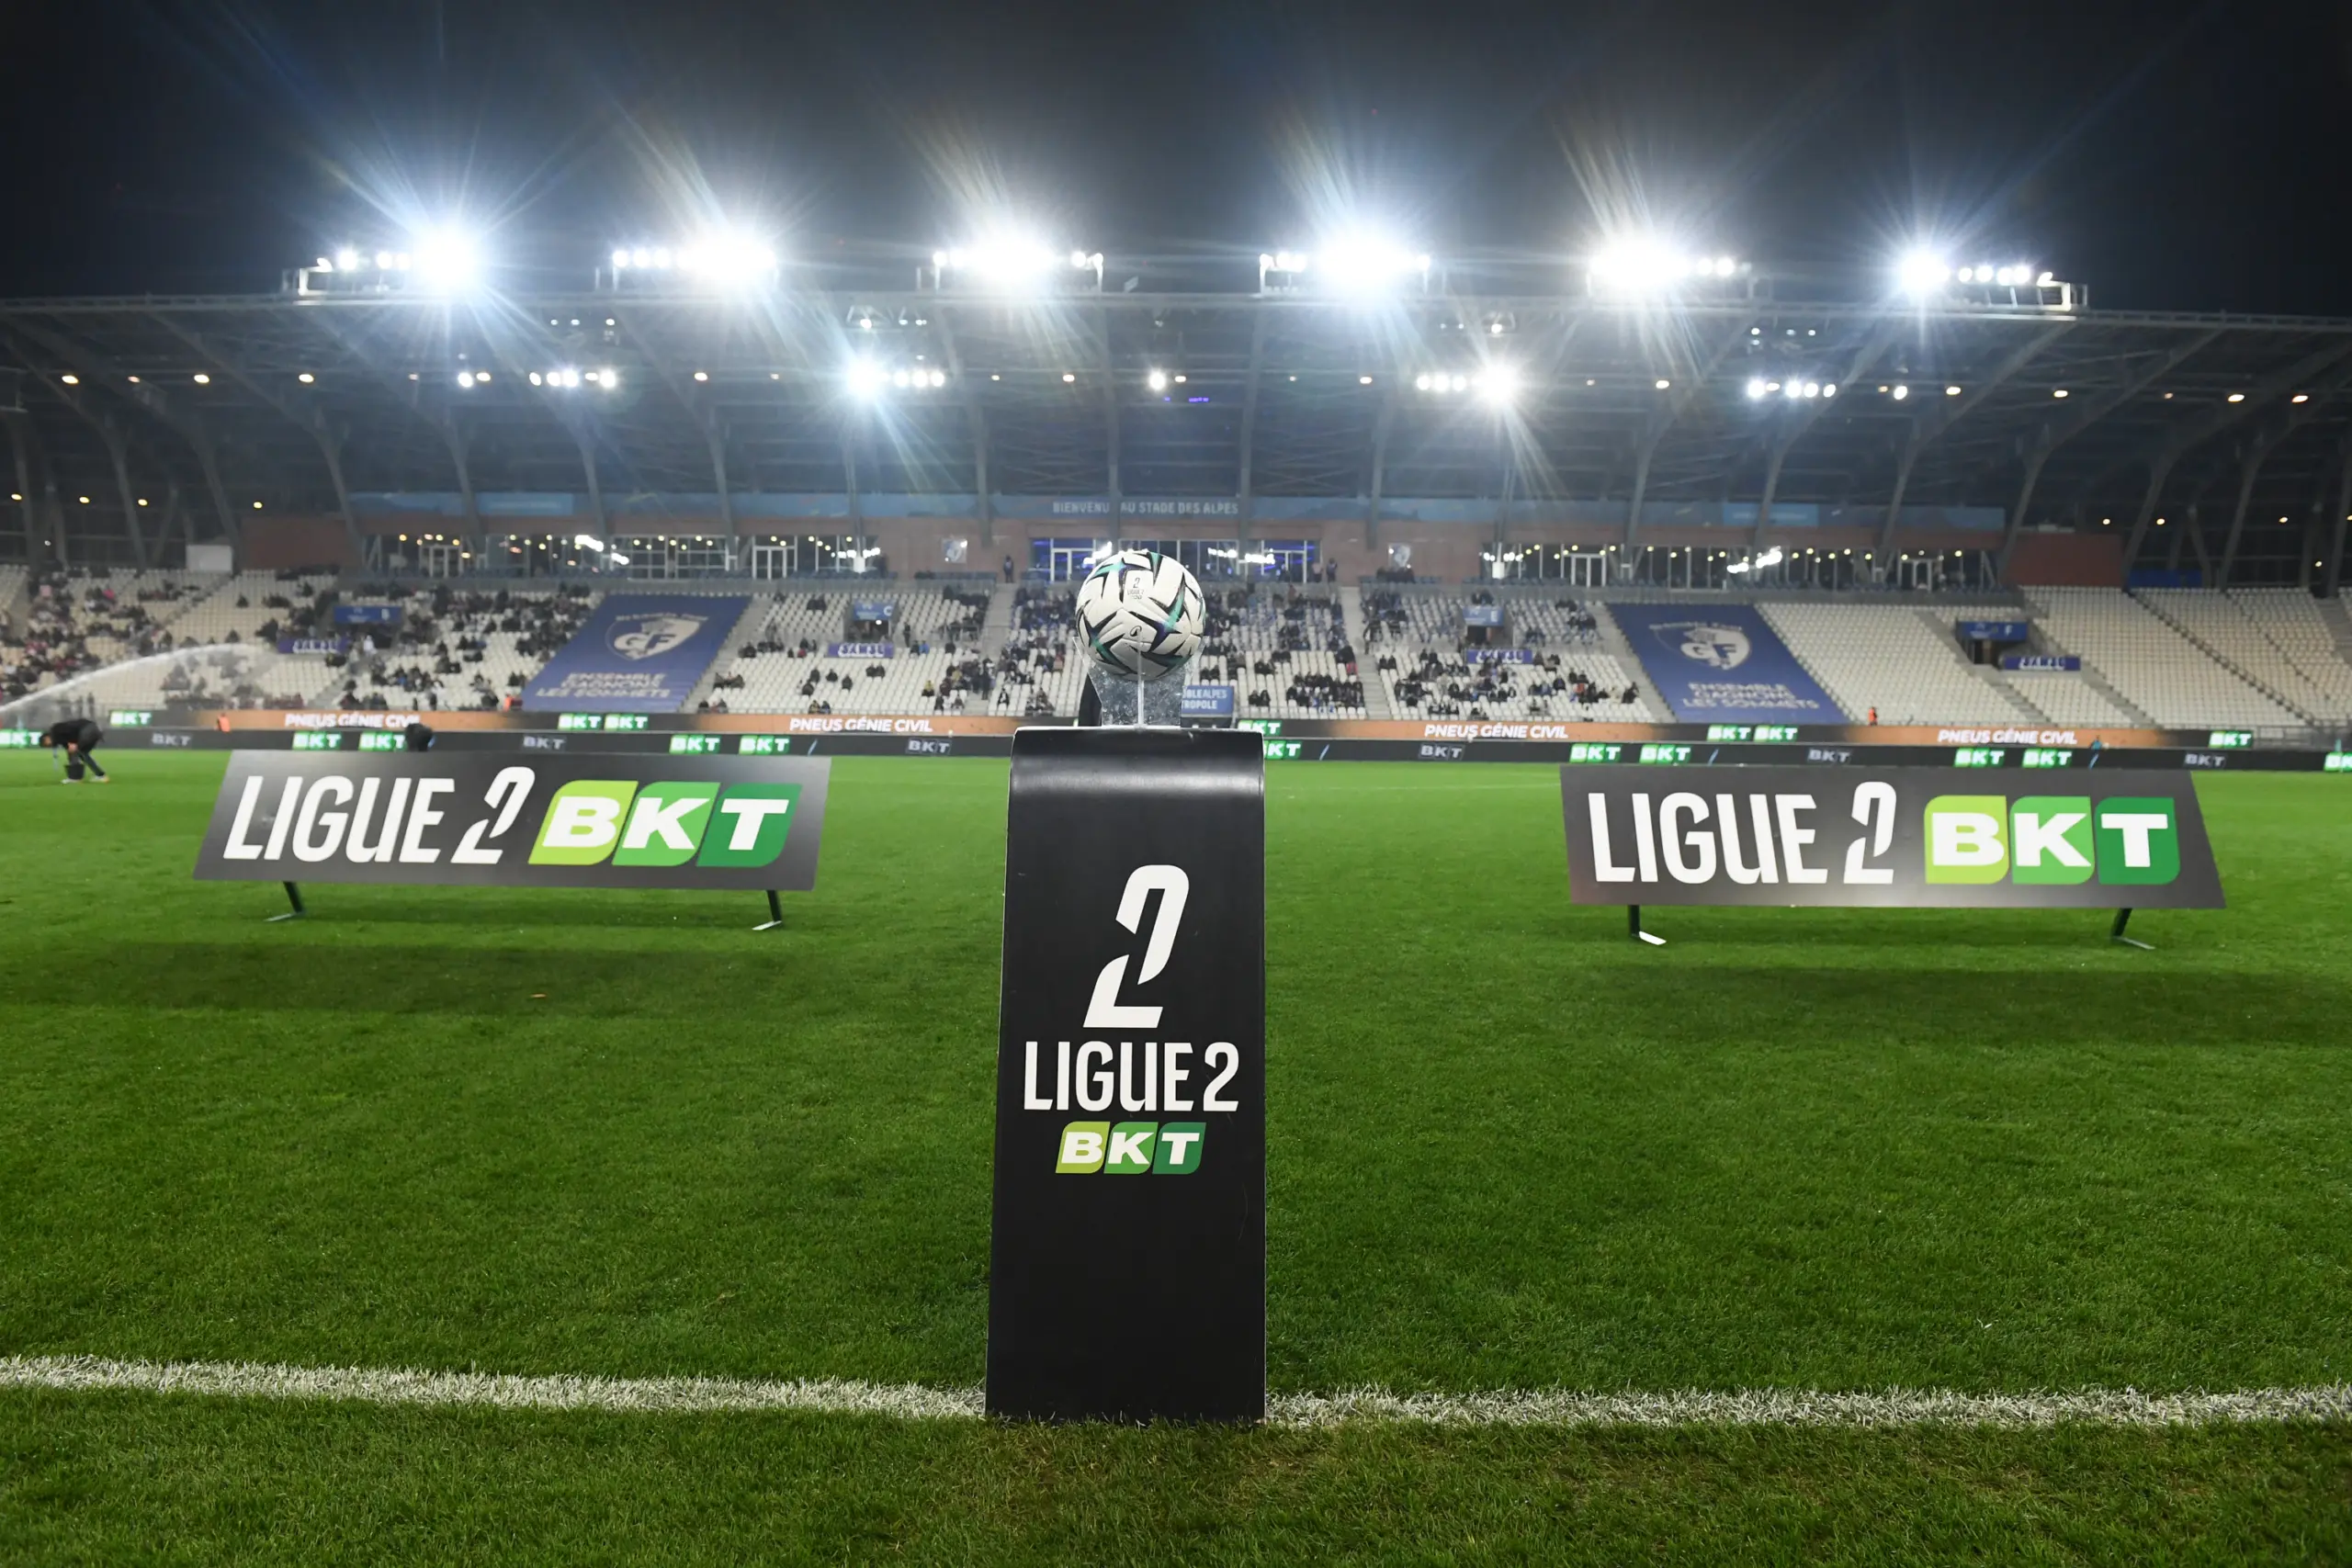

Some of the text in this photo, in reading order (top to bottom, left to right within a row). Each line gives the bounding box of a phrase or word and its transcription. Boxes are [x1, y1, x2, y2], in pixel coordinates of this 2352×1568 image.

[1138, 502, 1175, 513] STADE
[1178, 502, 1200, 514] DES
[1204, 502, 1238, 514] ALPES
[109, 711, 152, 726] BKT
[285, 714, 337, 728] PNEUS
[338, 711, 385, 728] GÉNIE
[559, 715, 649, 729] BKT BKT
[789, 716, 933, 733] PNEUS GÉNIE CIVIL
[1424, 722, 1568, 739] PNEUS GÉNIE CIVIL
[1707, 726, 1798, 740] BKT BKT
[1938, 728, 2078, 745] PNEUS GÉNIE CIVIL
[152, 733, 191, 747] BKT
[293, 733, 406, 750] BKT BKT
[523, 736, 565, 750] BKT
[670, 737, 790, 752] BKT BKT
[908, 739, 951, 753] BKT
[2209, 731, 2252, 747] BKT
[1263, 742, 1302, 757] KT
[1420, 744, 1463, 759] BKT
[1570, 745, 1691, 761] BKT BKT
[1808, 749, 1851, 763] BKT
[1955, 750, 2073, 766] BKT BKT
[2185, 752, 2226, 767] BKT
[223, 766, 792, 864] LIGUE 2 BKT
[1588, 781, 2171, 885] LIGUE 2 BKT
[1082, 864, 1190, 1028] 2
[1023, 1041, 1239, 1111] LIGUE 2
[1059, 1130, 1202, 1166] BKT
